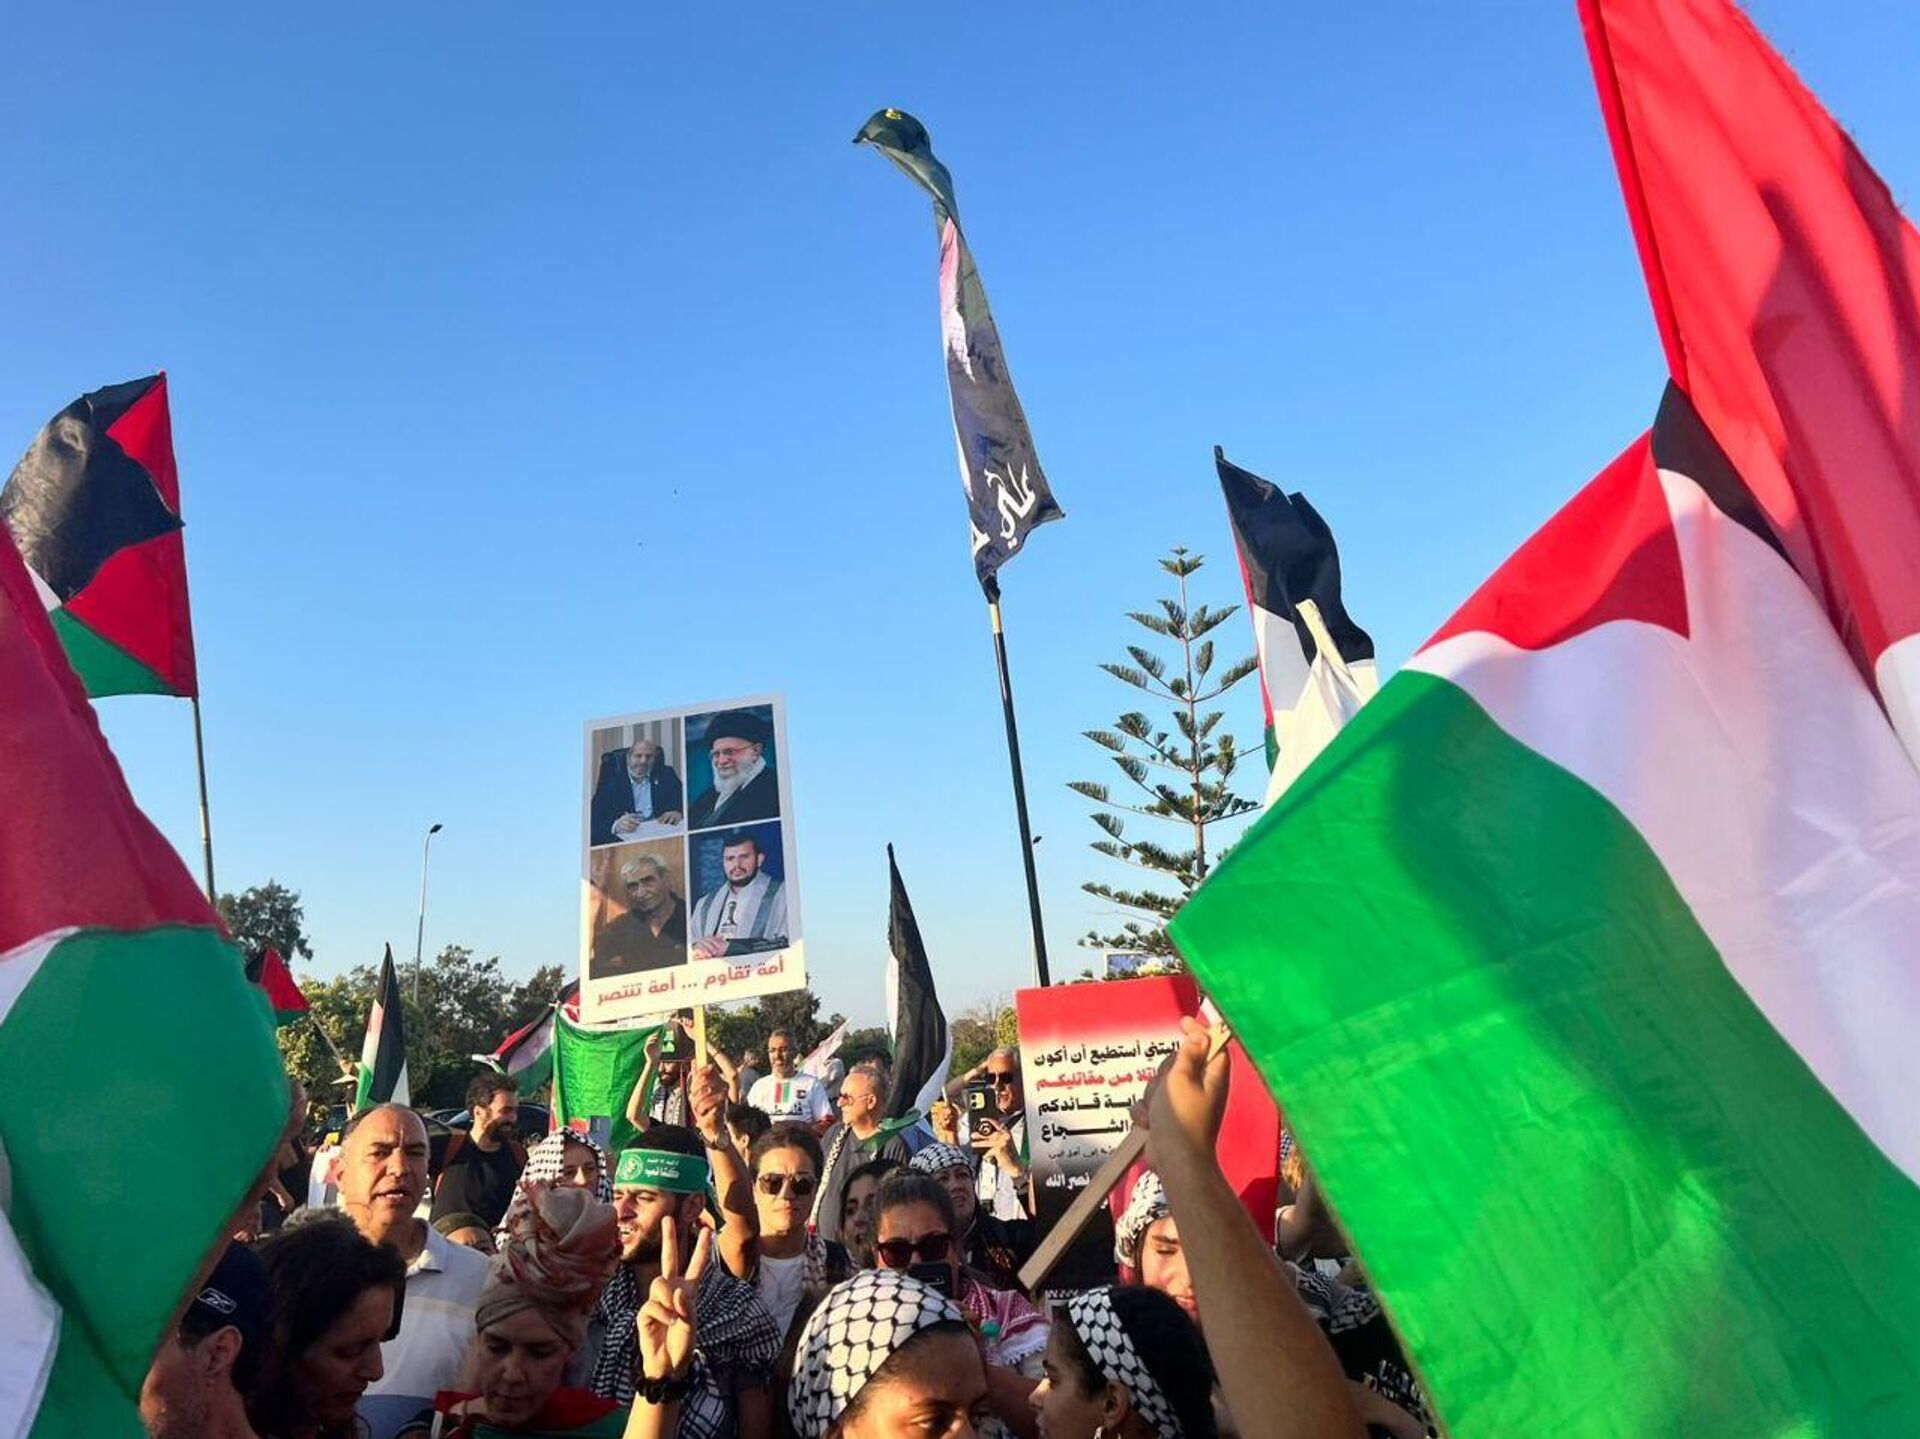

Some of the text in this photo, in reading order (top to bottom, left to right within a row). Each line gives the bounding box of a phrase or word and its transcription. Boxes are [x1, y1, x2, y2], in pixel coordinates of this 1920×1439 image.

[704, 964, 752, 989] تقاوم
[598, 982, 643, 1006] تنتصر
[1034, 1045, 1068, 1067] أكون
[1070, 1043, 1087, 1063] أن
[1090, 1039, 1141, 1066] أستطيع
[1036, 1070, 1106, 1091] مقاتليكم
[1108, 1070, 1133, 1087] من
[1038, 1092, 1101, 1116] قائدكم
[1041, 1119, 1130, 1143] الشجاع
[1045, 1173, 1066, 1188] الله
